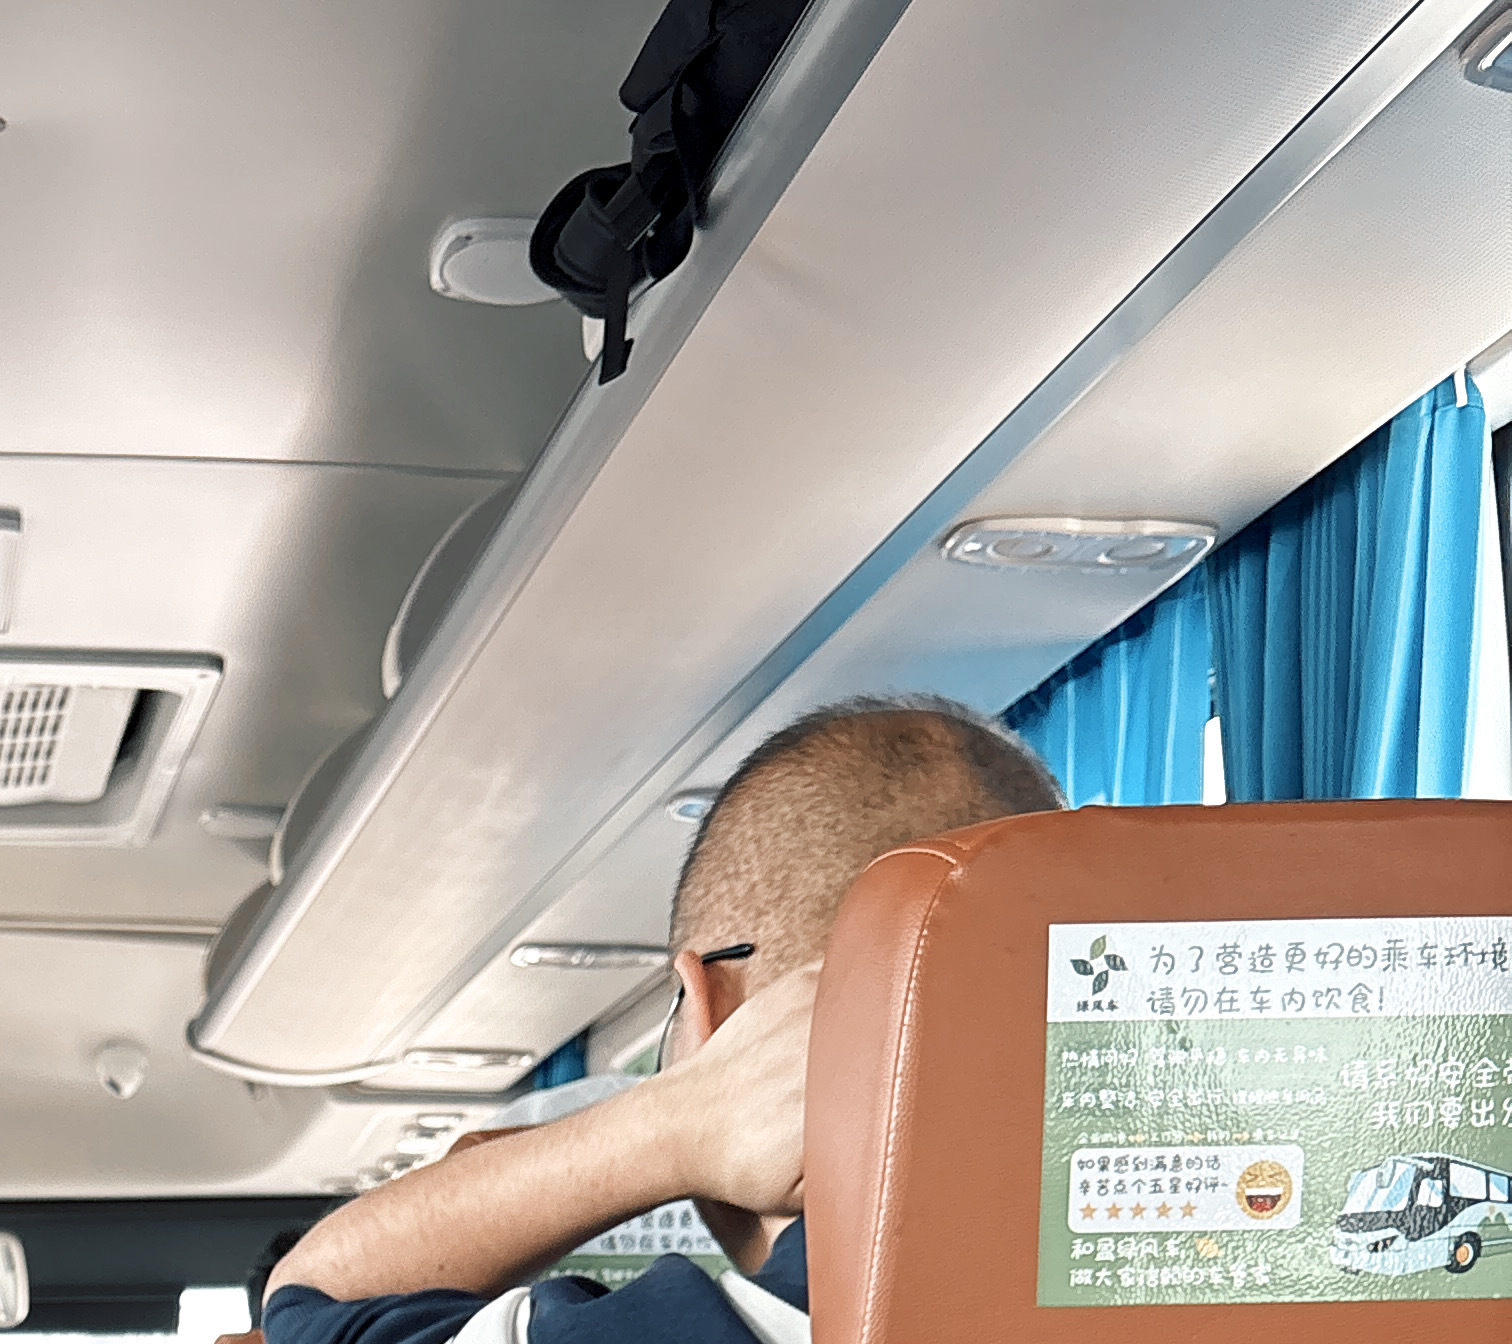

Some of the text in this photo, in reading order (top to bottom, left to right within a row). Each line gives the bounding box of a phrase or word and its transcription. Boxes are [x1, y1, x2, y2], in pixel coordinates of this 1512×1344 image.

[1149, 936, 1509, 976] 为了营造更好的乘车环境
[1145, 982, 1384, 1016] 请勿在车内饮食！
[1076, 1153, 1222, 1175] 如果感到满意的话
